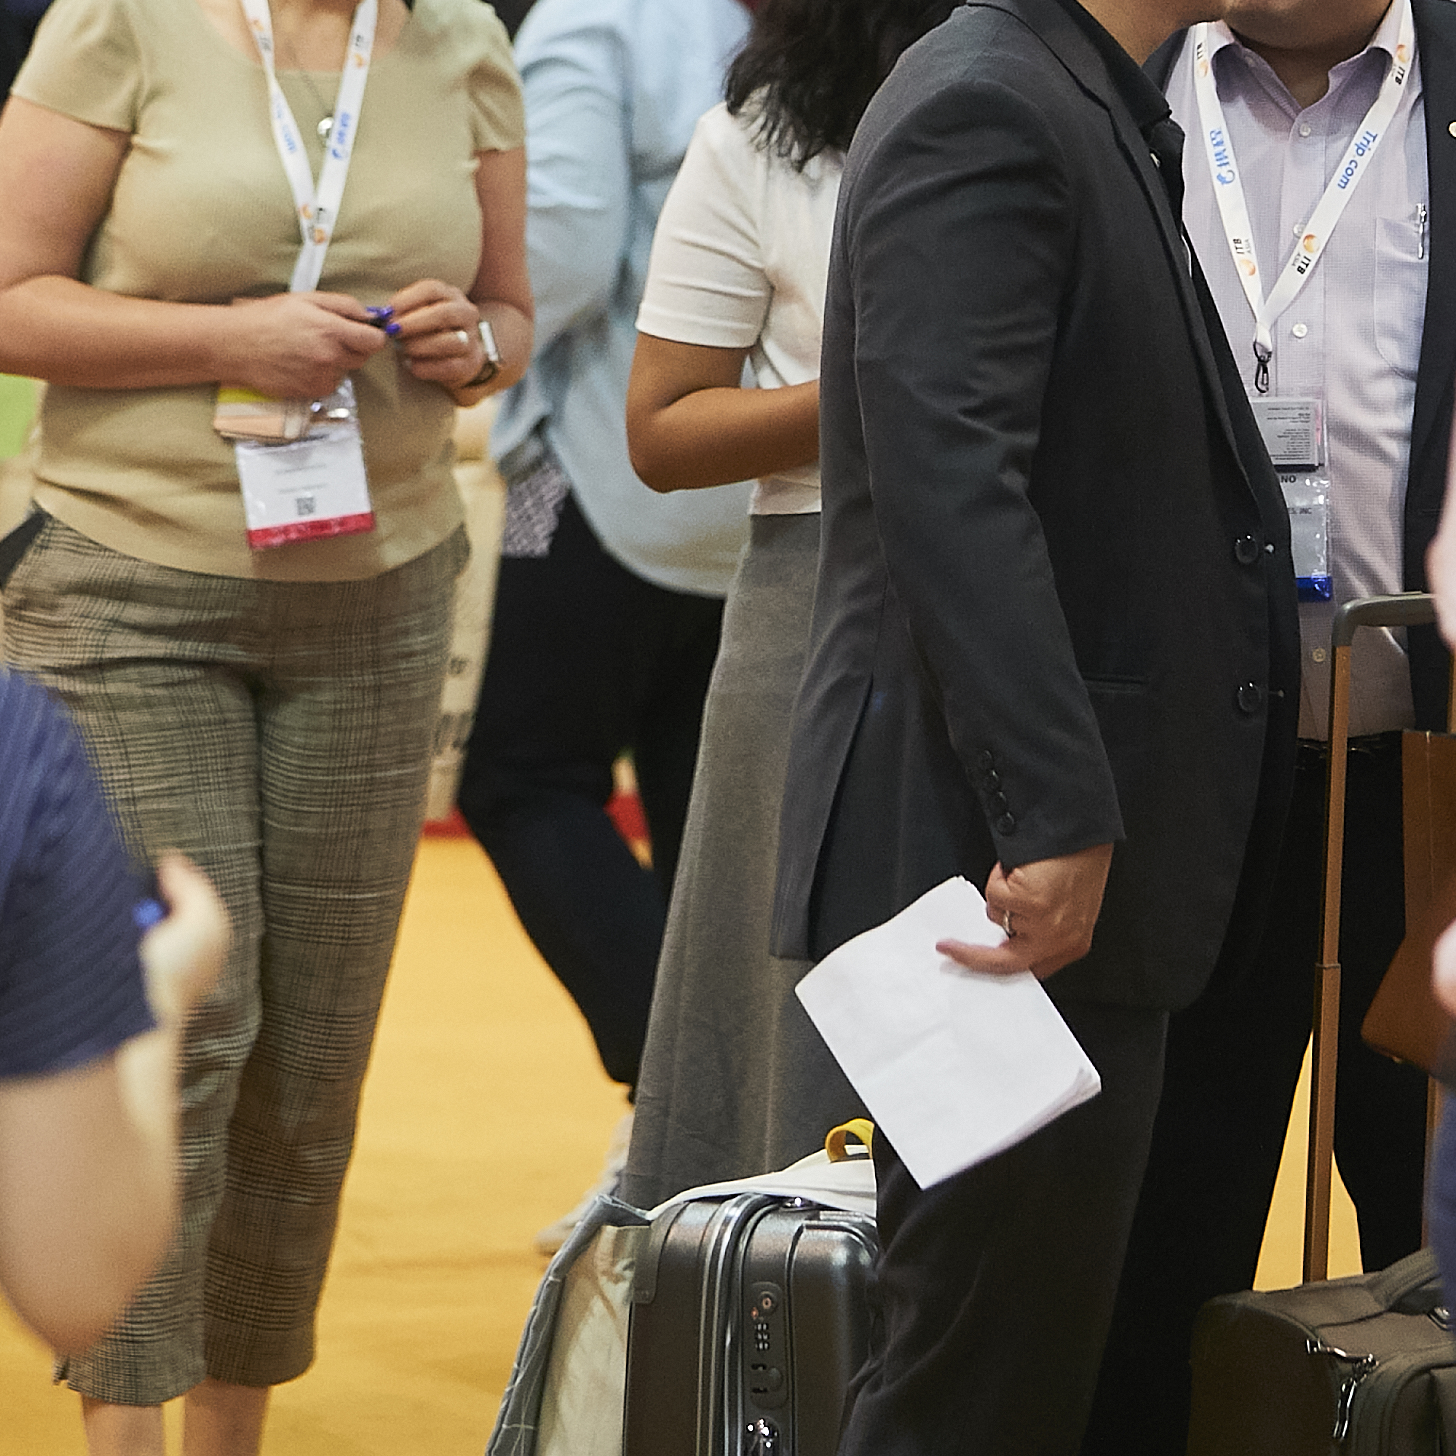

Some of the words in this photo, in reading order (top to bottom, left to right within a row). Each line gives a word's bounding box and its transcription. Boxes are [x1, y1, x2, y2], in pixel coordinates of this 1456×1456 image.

[1395, 66, 1406, 85] ITB
[1337, 130, 1379, 190] Trip.com
[1233, 238, 1245, 255] ITB
[1297, 255, 1312, 275] ITB
